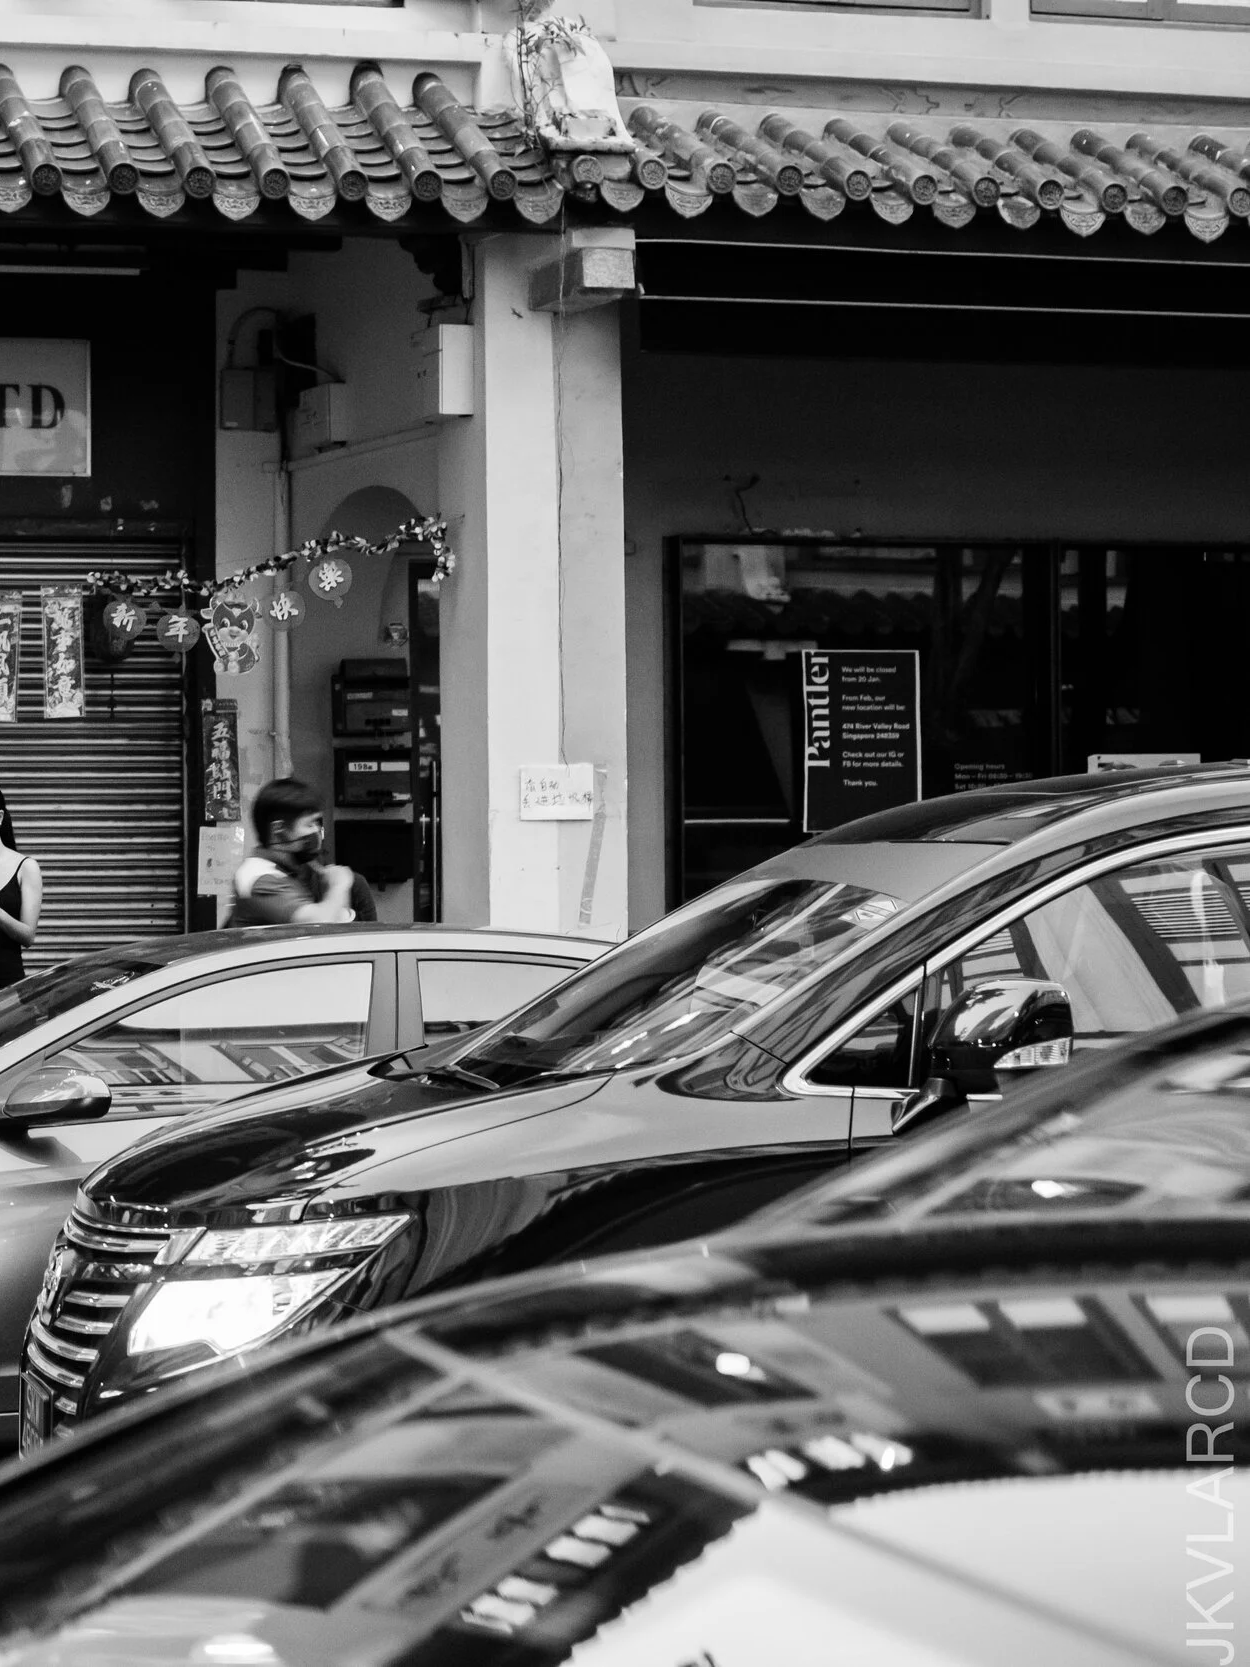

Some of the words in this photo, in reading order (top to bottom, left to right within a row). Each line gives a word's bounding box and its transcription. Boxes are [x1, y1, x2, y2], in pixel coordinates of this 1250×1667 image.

[805, 651, 831, 768] Pantler
[873, 723, 892, 731] Valley
[842, 732, 875, 740] Singapore
